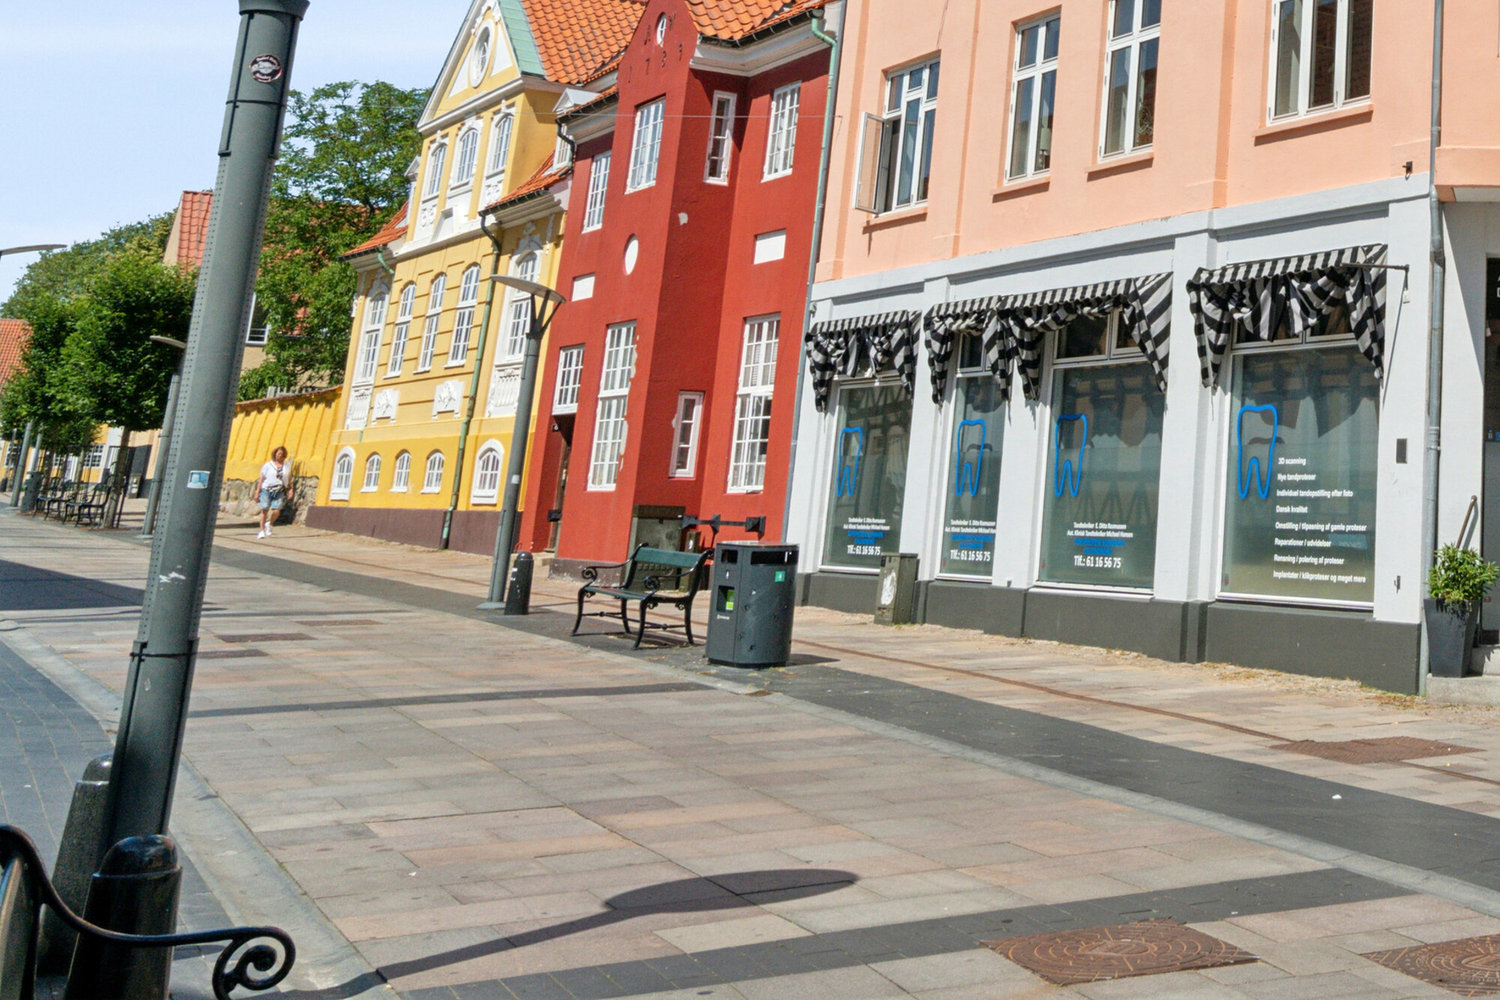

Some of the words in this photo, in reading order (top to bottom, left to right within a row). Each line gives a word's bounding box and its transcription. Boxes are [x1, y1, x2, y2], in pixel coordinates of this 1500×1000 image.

[951, 550, 960, 560] Tlf.:
[961, 550, 967, 560] 61
[969, 550, 975, 560] 16
[976, 551, 983, 561] 56
[984, 551, 990, 561] 75
[1074, 555, 1085, 566] Tlf.:
[1086, 556, 1094, 567] 61
[1095, 556, 1103, 567] 16
[1104, 557, 1112, 568] 56
[1113, 558, 1121, 568] 75
